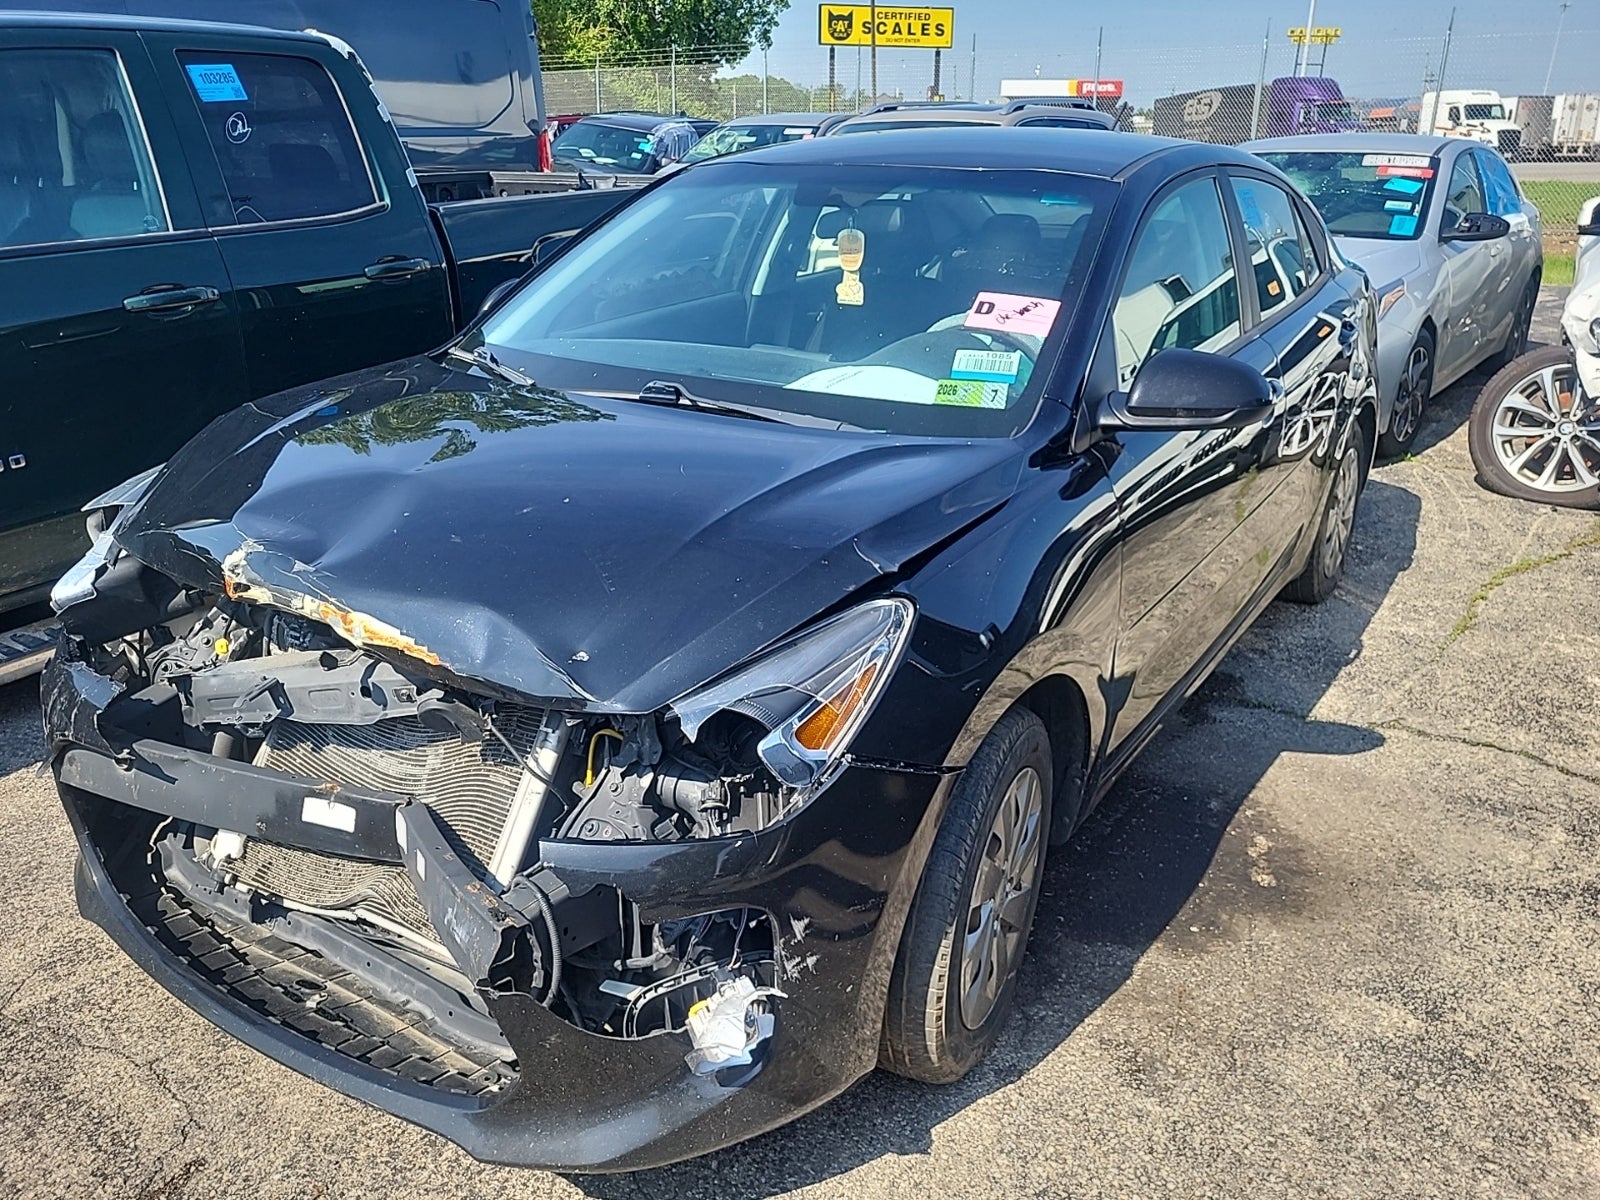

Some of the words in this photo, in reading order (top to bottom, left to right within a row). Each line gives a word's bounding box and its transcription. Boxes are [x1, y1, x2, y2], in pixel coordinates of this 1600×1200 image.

[876, 11, 931, 21] CERTIFIED
[831, 20, 850, 32] CAT
[861, 20, 945, 37] SCALES
[198, 71, 236, 85] 103285
[974, 300, 996, 315] D
[937, 383, 958, 396] 2026
[990, 389, 999, 403] 7
